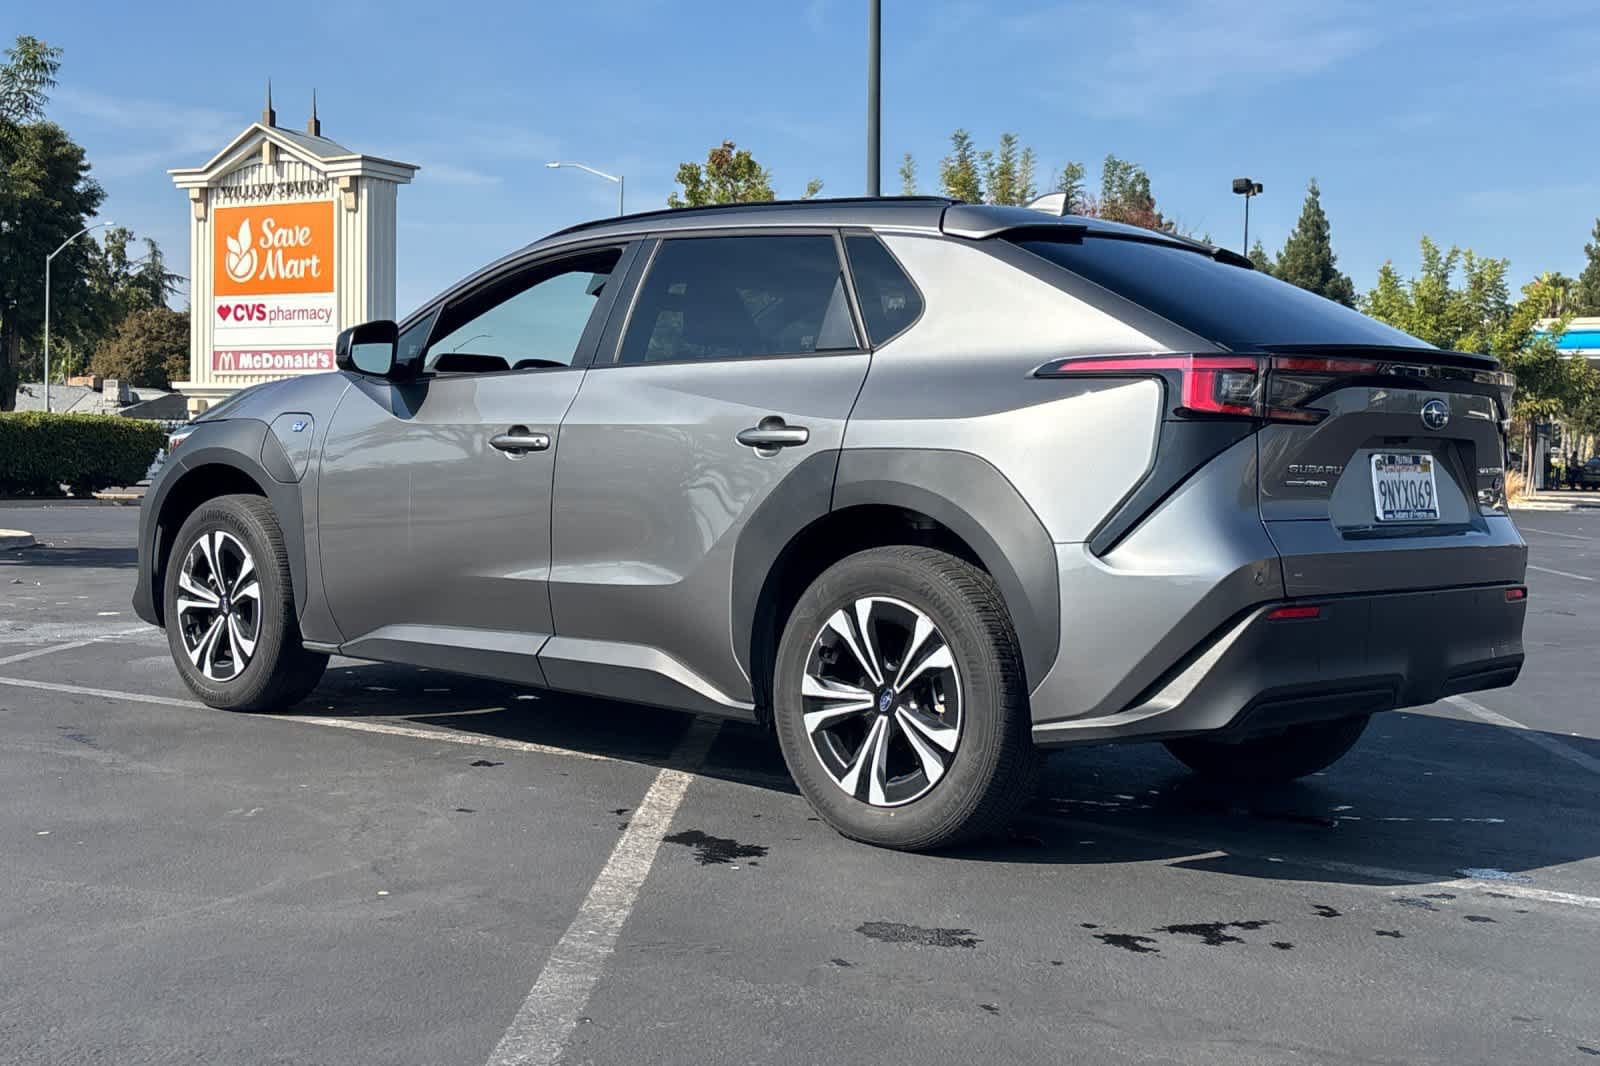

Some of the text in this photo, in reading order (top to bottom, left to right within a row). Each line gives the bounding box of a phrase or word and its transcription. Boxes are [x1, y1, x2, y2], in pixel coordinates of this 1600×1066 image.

[259, 217, 312, 249] Save
[259, 248, 321, 280] Mart
[233, 303, 333, 324] CVS pharmacy
[238, 352, 330, 369] McDonald's
[1288, 464, 1343, 474] SUBARU
[1379, 479, 1433, 509] 9NYX069
